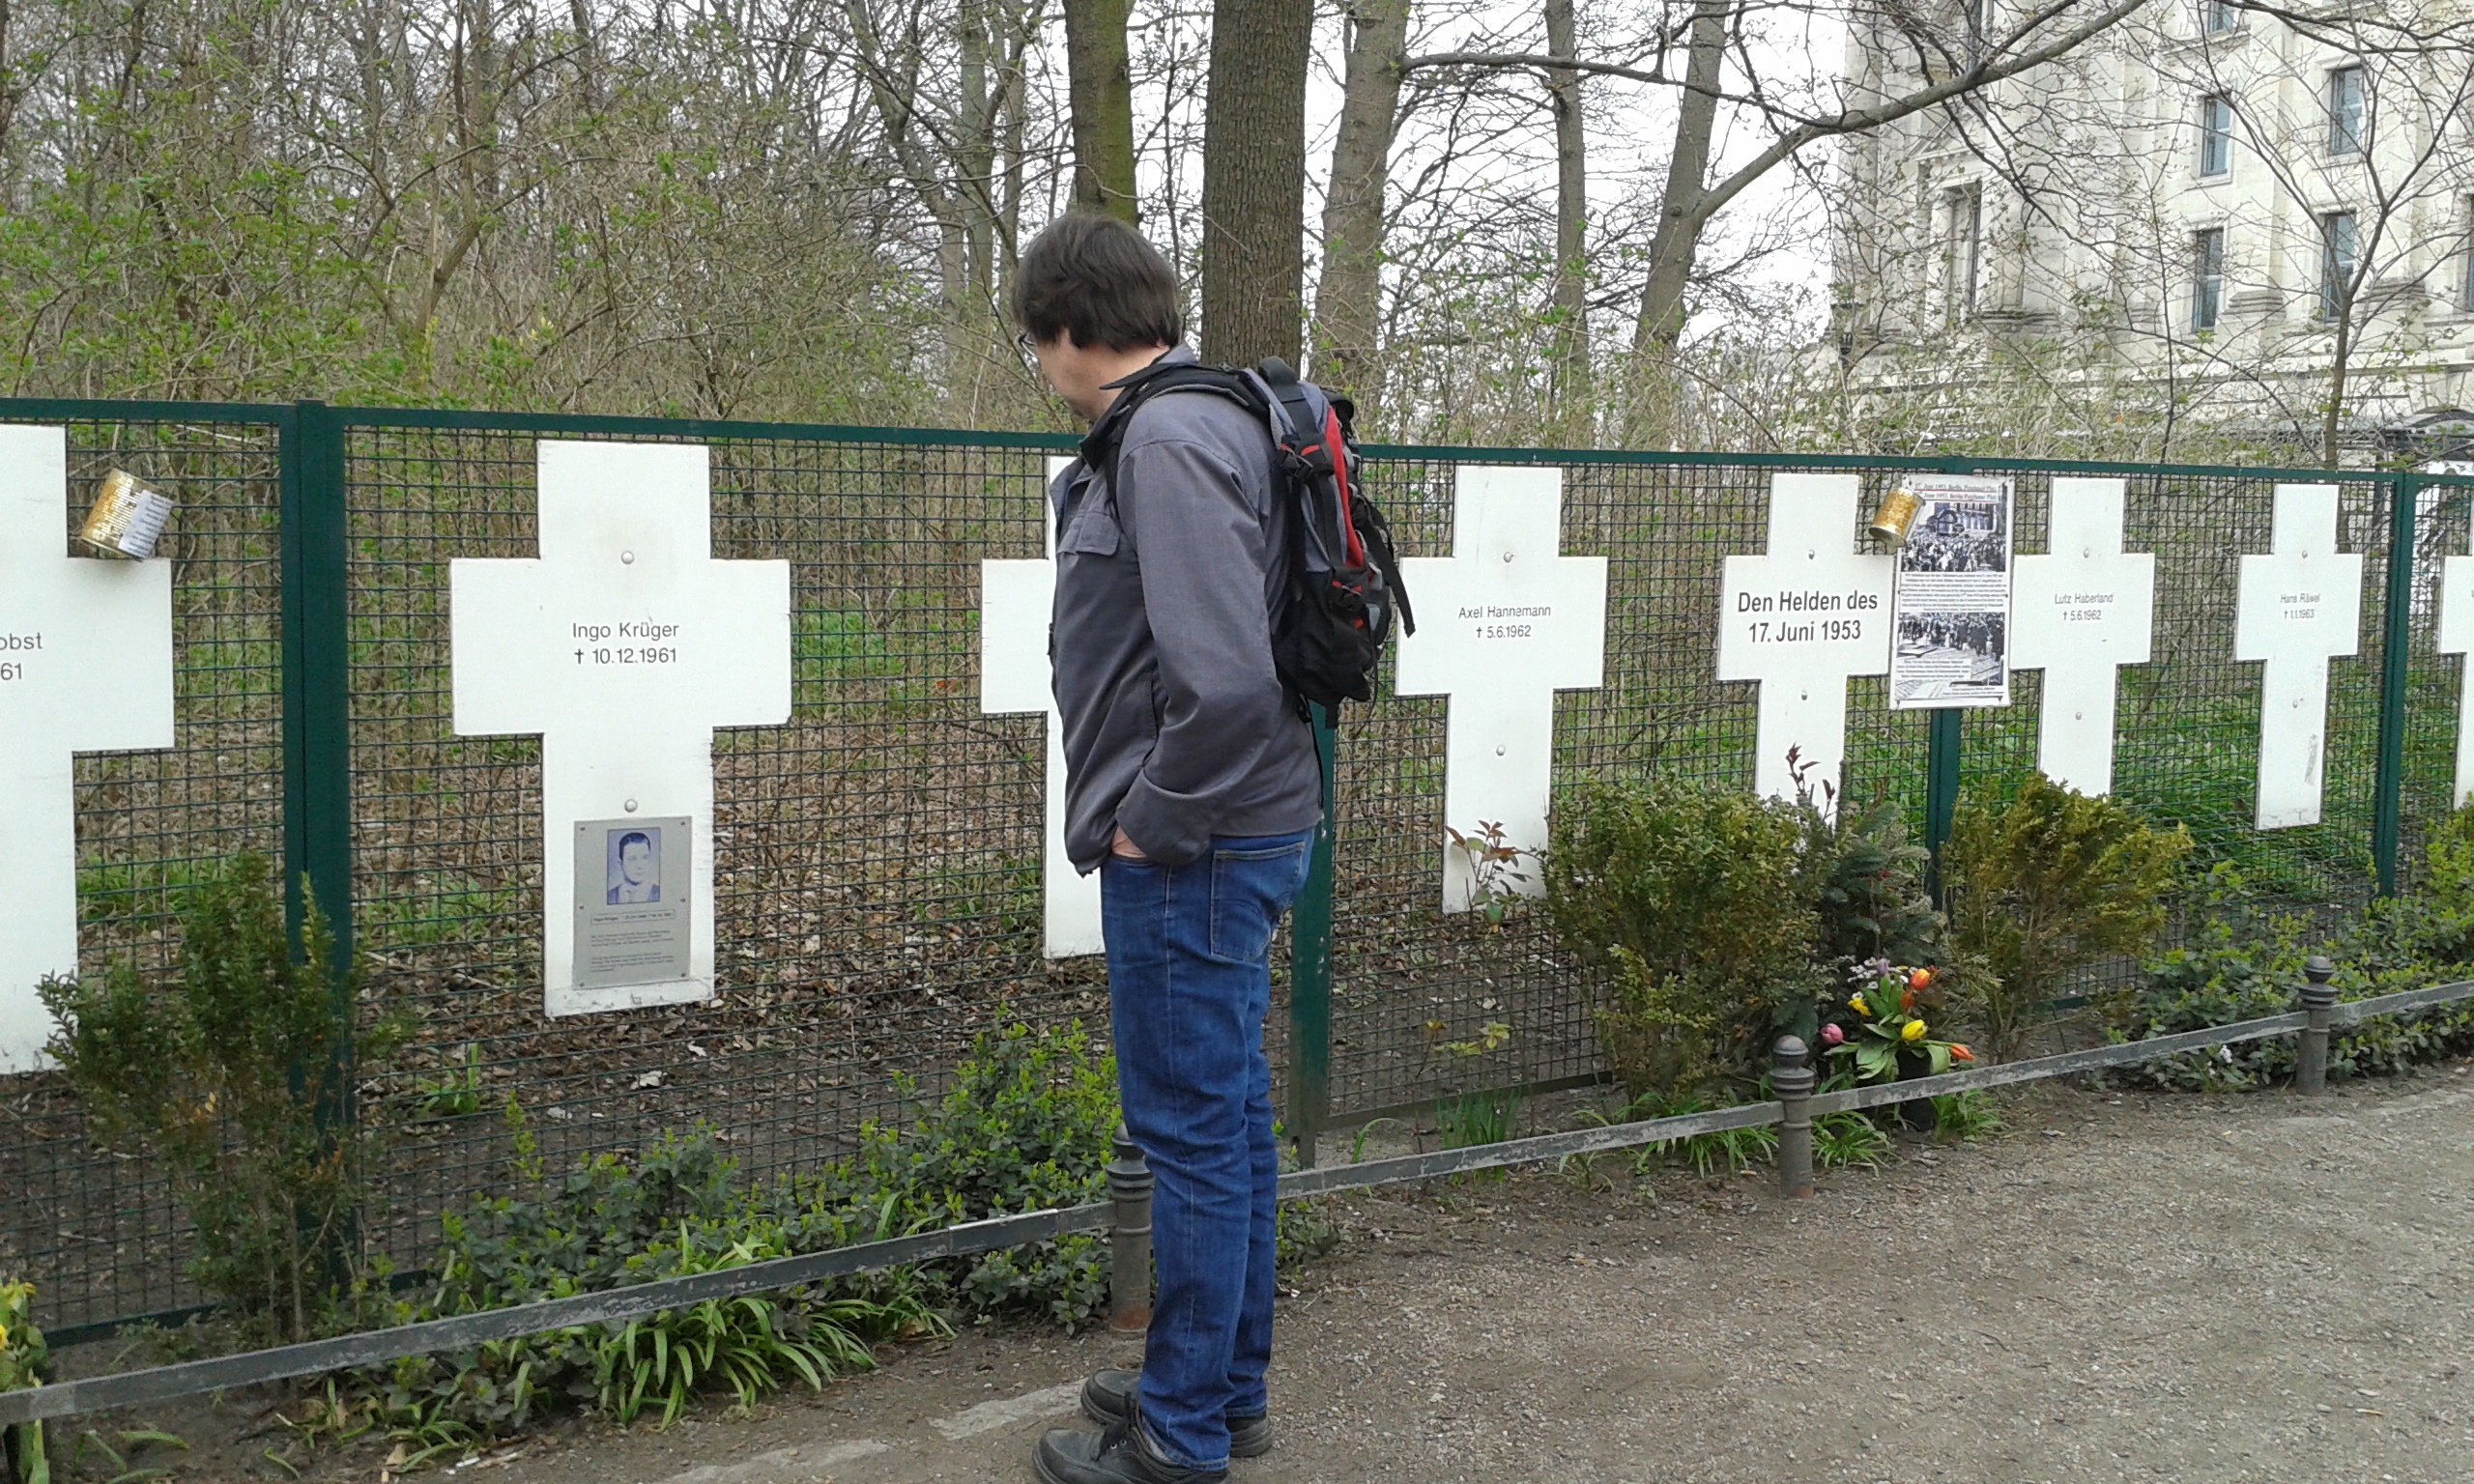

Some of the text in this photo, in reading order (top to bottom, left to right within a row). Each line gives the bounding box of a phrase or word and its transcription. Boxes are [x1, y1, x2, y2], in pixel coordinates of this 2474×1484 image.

[1738, 591, 1772, 613] Den
[1779, 590, 1841, 612] Helden
[1847, 589, 1878, 611] des
[2055, 592, 2114, 604] Lutz Haberland
[1458, 605, 1551, 618] Axel Hannemann
[572, 621, 679, 642] Ingo Krüger
[1486, 624, 1532, 639] 5.6.1962
[1748, 619, 1861, 642] 17. Juni 1953
[592, 647, 676, 664] 10.12.1961
